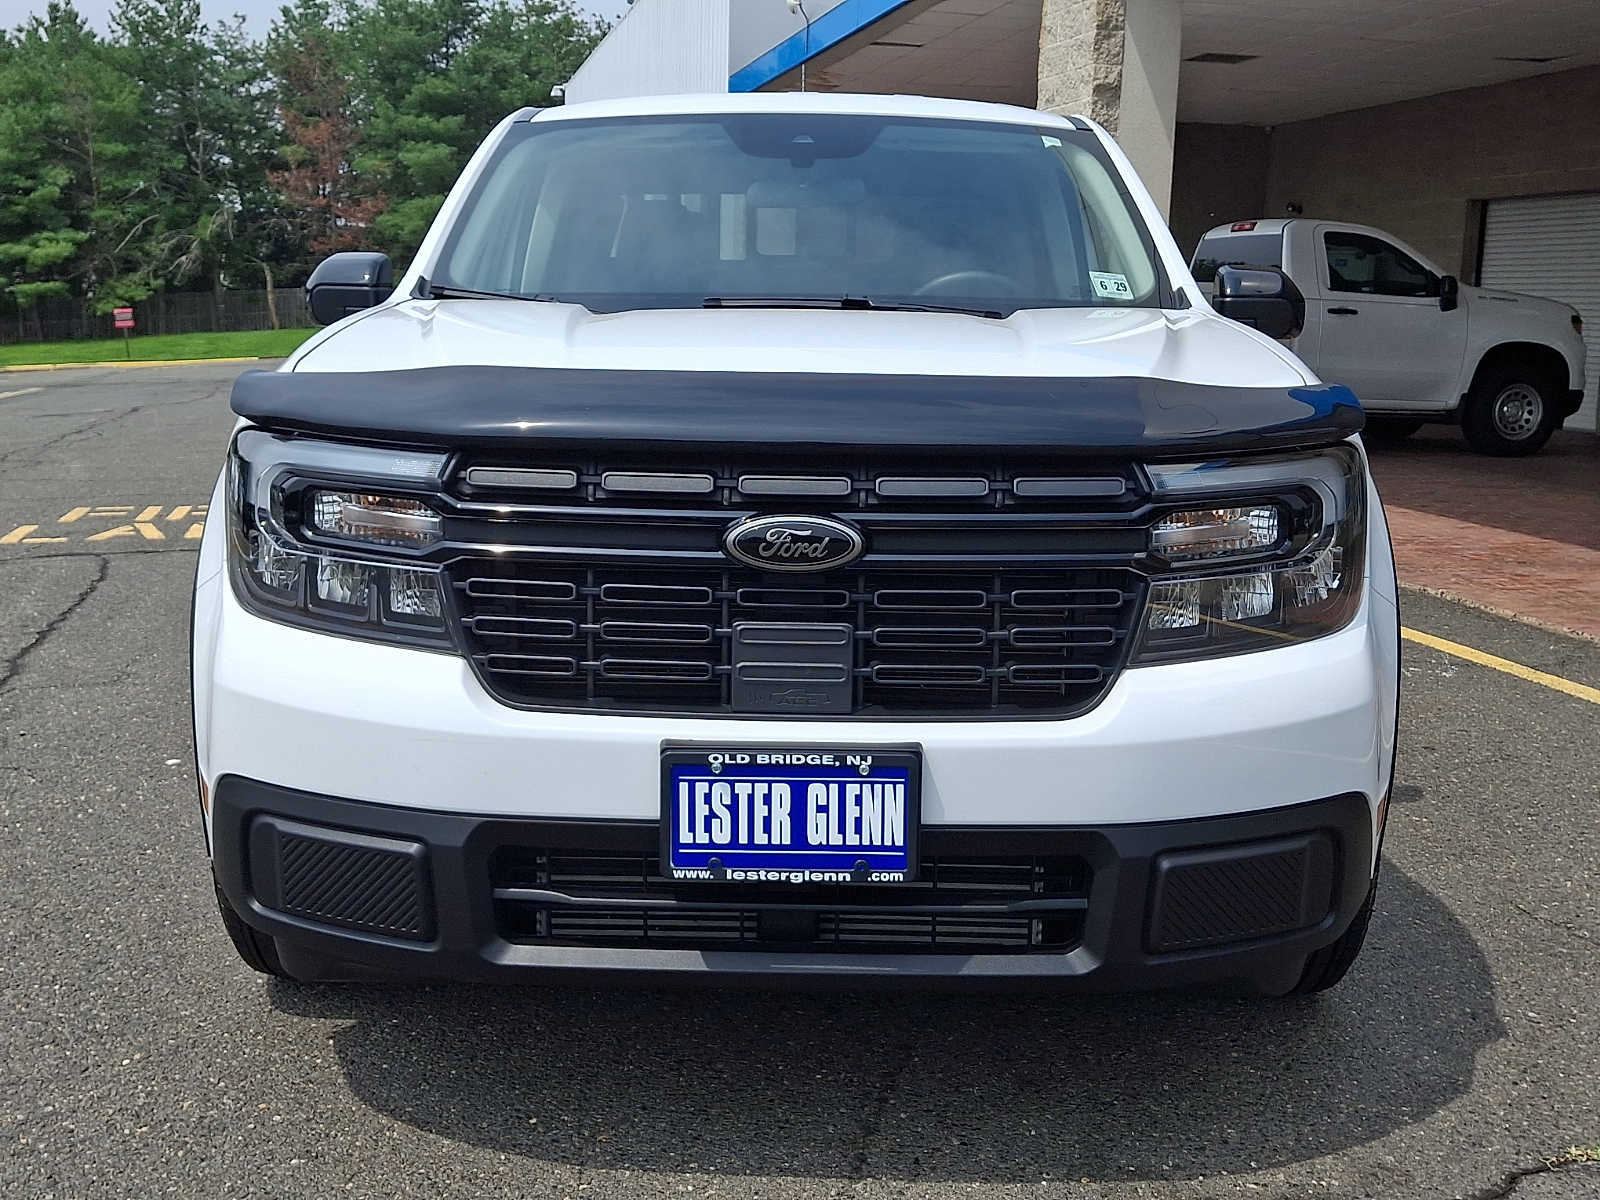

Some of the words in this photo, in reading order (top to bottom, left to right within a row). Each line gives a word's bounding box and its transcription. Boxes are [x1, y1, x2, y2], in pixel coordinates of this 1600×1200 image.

[1099, 280, 1108, 291] 6
[1113, 281, 1128, 292] 29
[758, 528, 830, 558] Ford
[708, 753, 750, 764] OLD
[756, 754, 840, 767] BRIDGE,
[846, 755, 872, 766] NJ
[679, 781, 791, 845] LESTER
[807, 782, 904, 847] GLENN
[726, 868, 850, 883] lesterglenn
